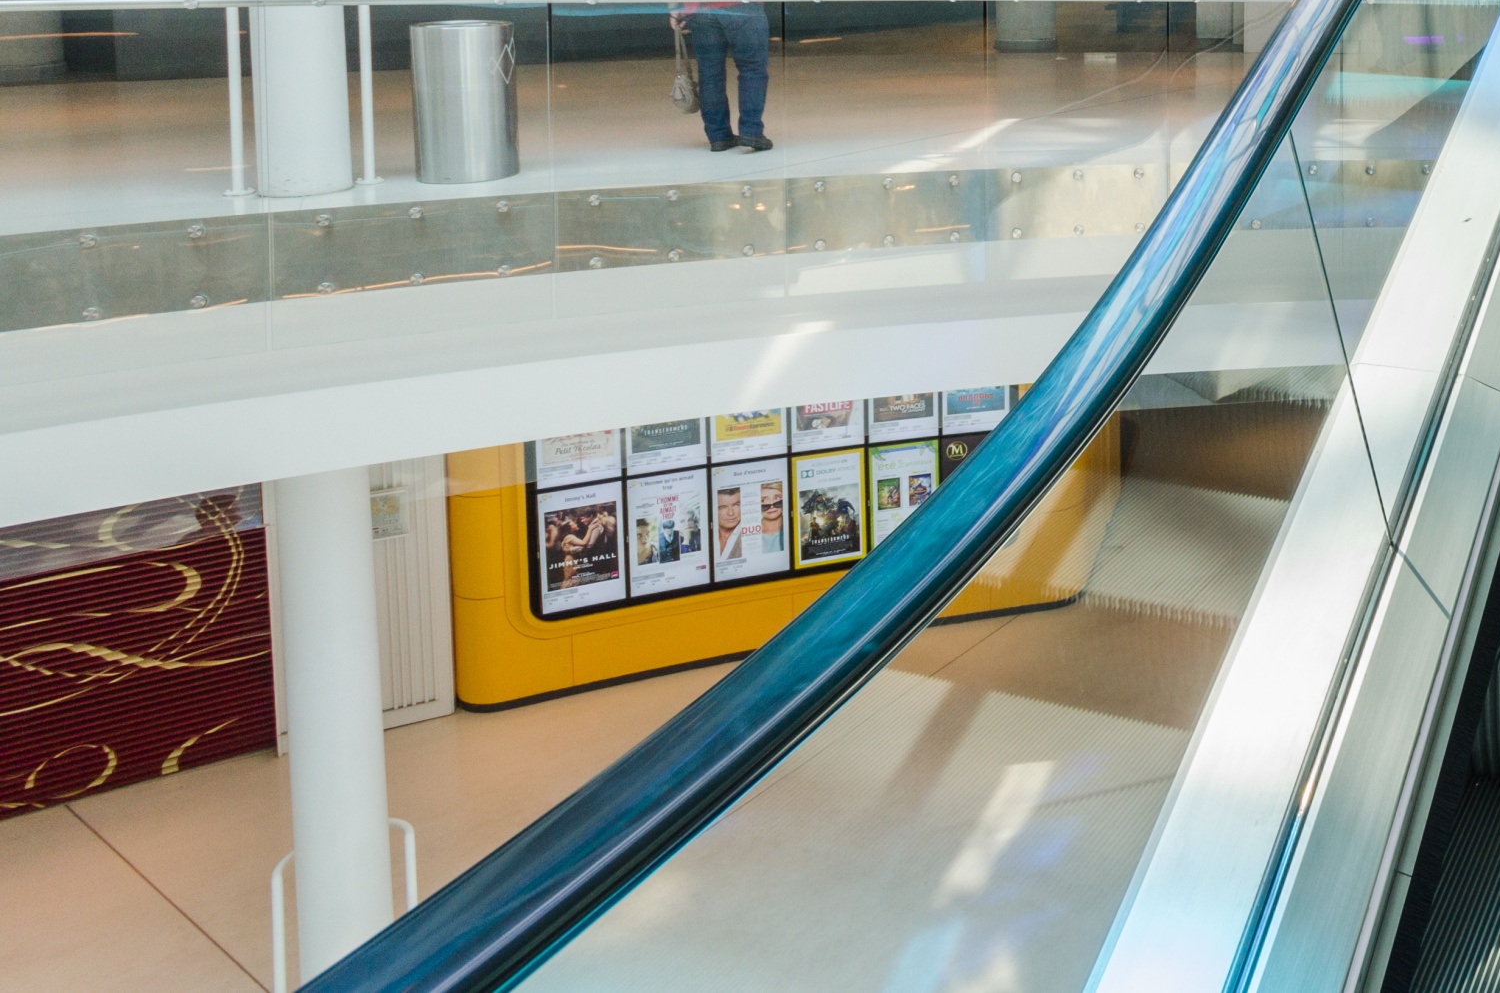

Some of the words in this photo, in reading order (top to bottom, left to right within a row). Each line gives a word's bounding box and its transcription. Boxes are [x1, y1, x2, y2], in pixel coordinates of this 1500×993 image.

[805, 401, 851, 413] FASTLIFE
[643, 424, 688, 436] TRANSFORMERS
[741, 524, 761, 535] DUO
[549, 557, 589, 570] JIMMY'S
[592, 552, 617, 562] HALL
